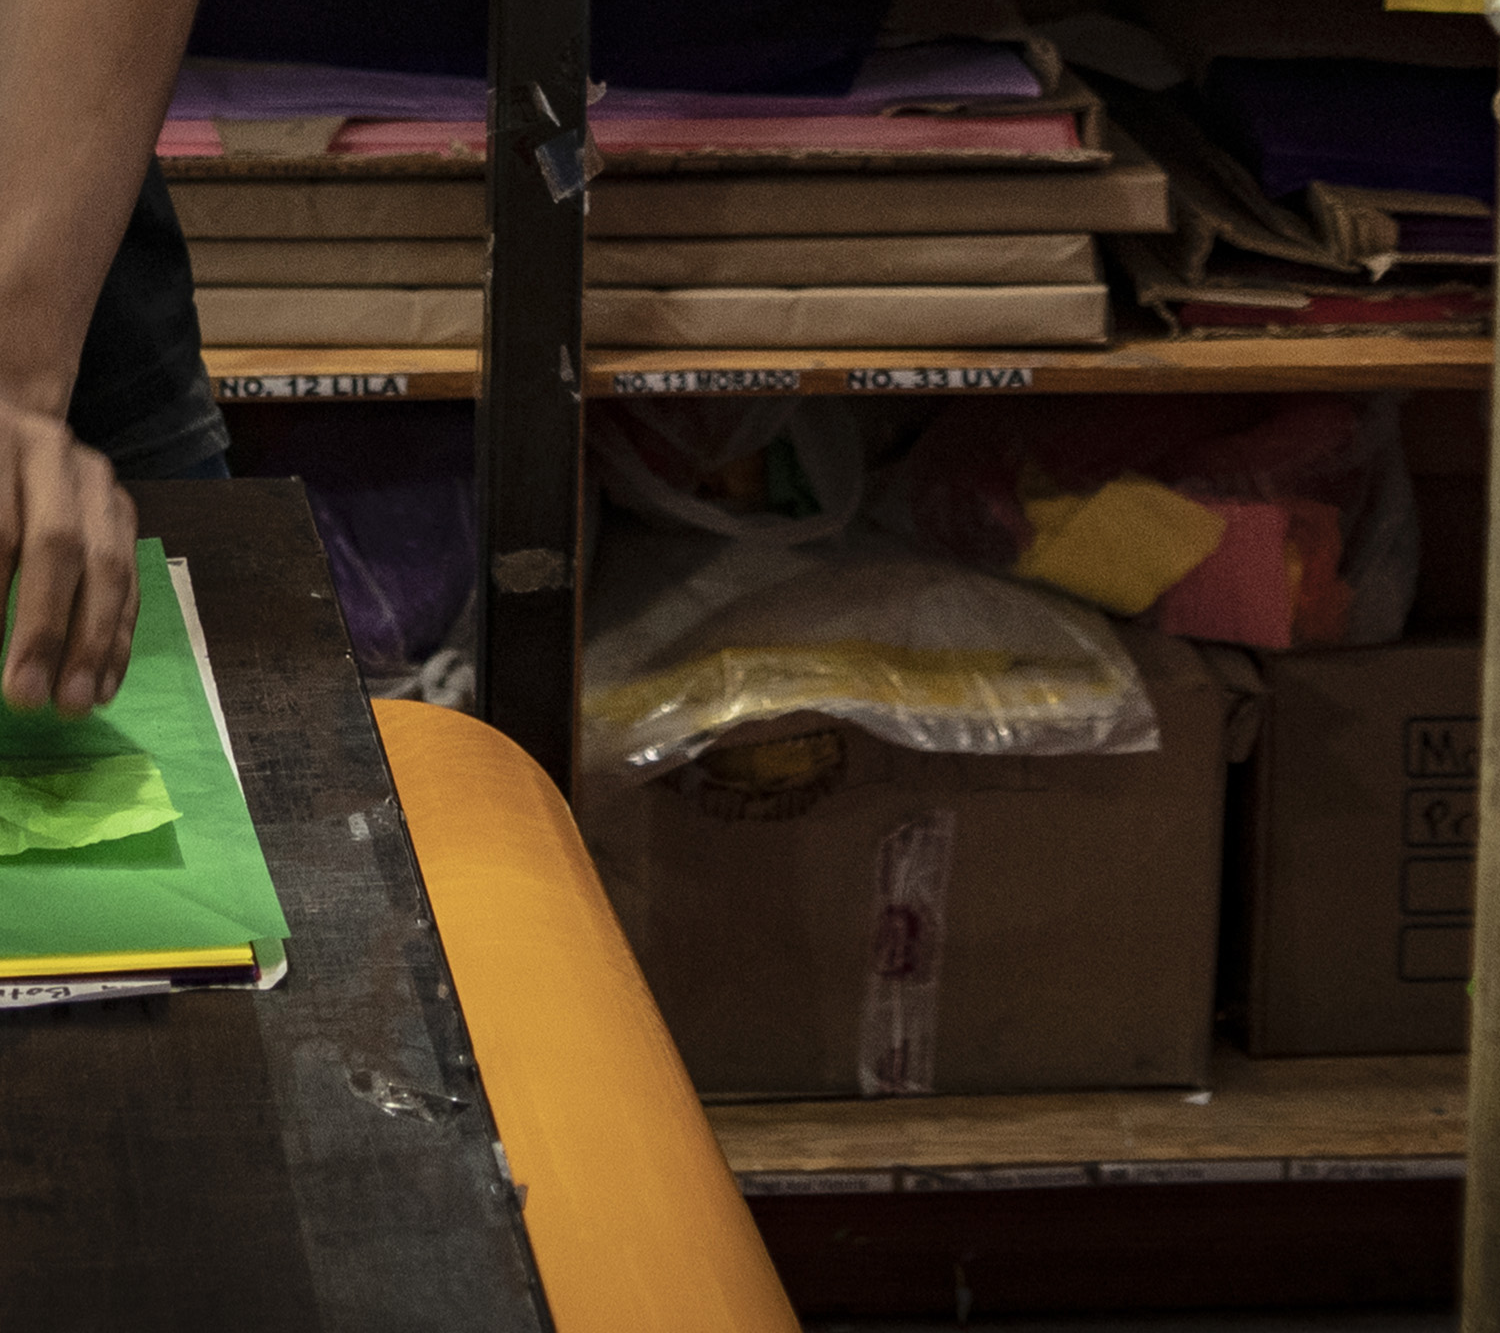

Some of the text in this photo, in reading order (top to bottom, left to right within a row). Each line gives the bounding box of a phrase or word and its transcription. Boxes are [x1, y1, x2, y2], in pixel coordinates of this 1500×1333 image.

[219, 376, 399, 398] NO. 12 LILA
[612, 372, 798, 393] NO. 13 MORADO
[846, 369, 1027, 390] NO. 33 UVA
